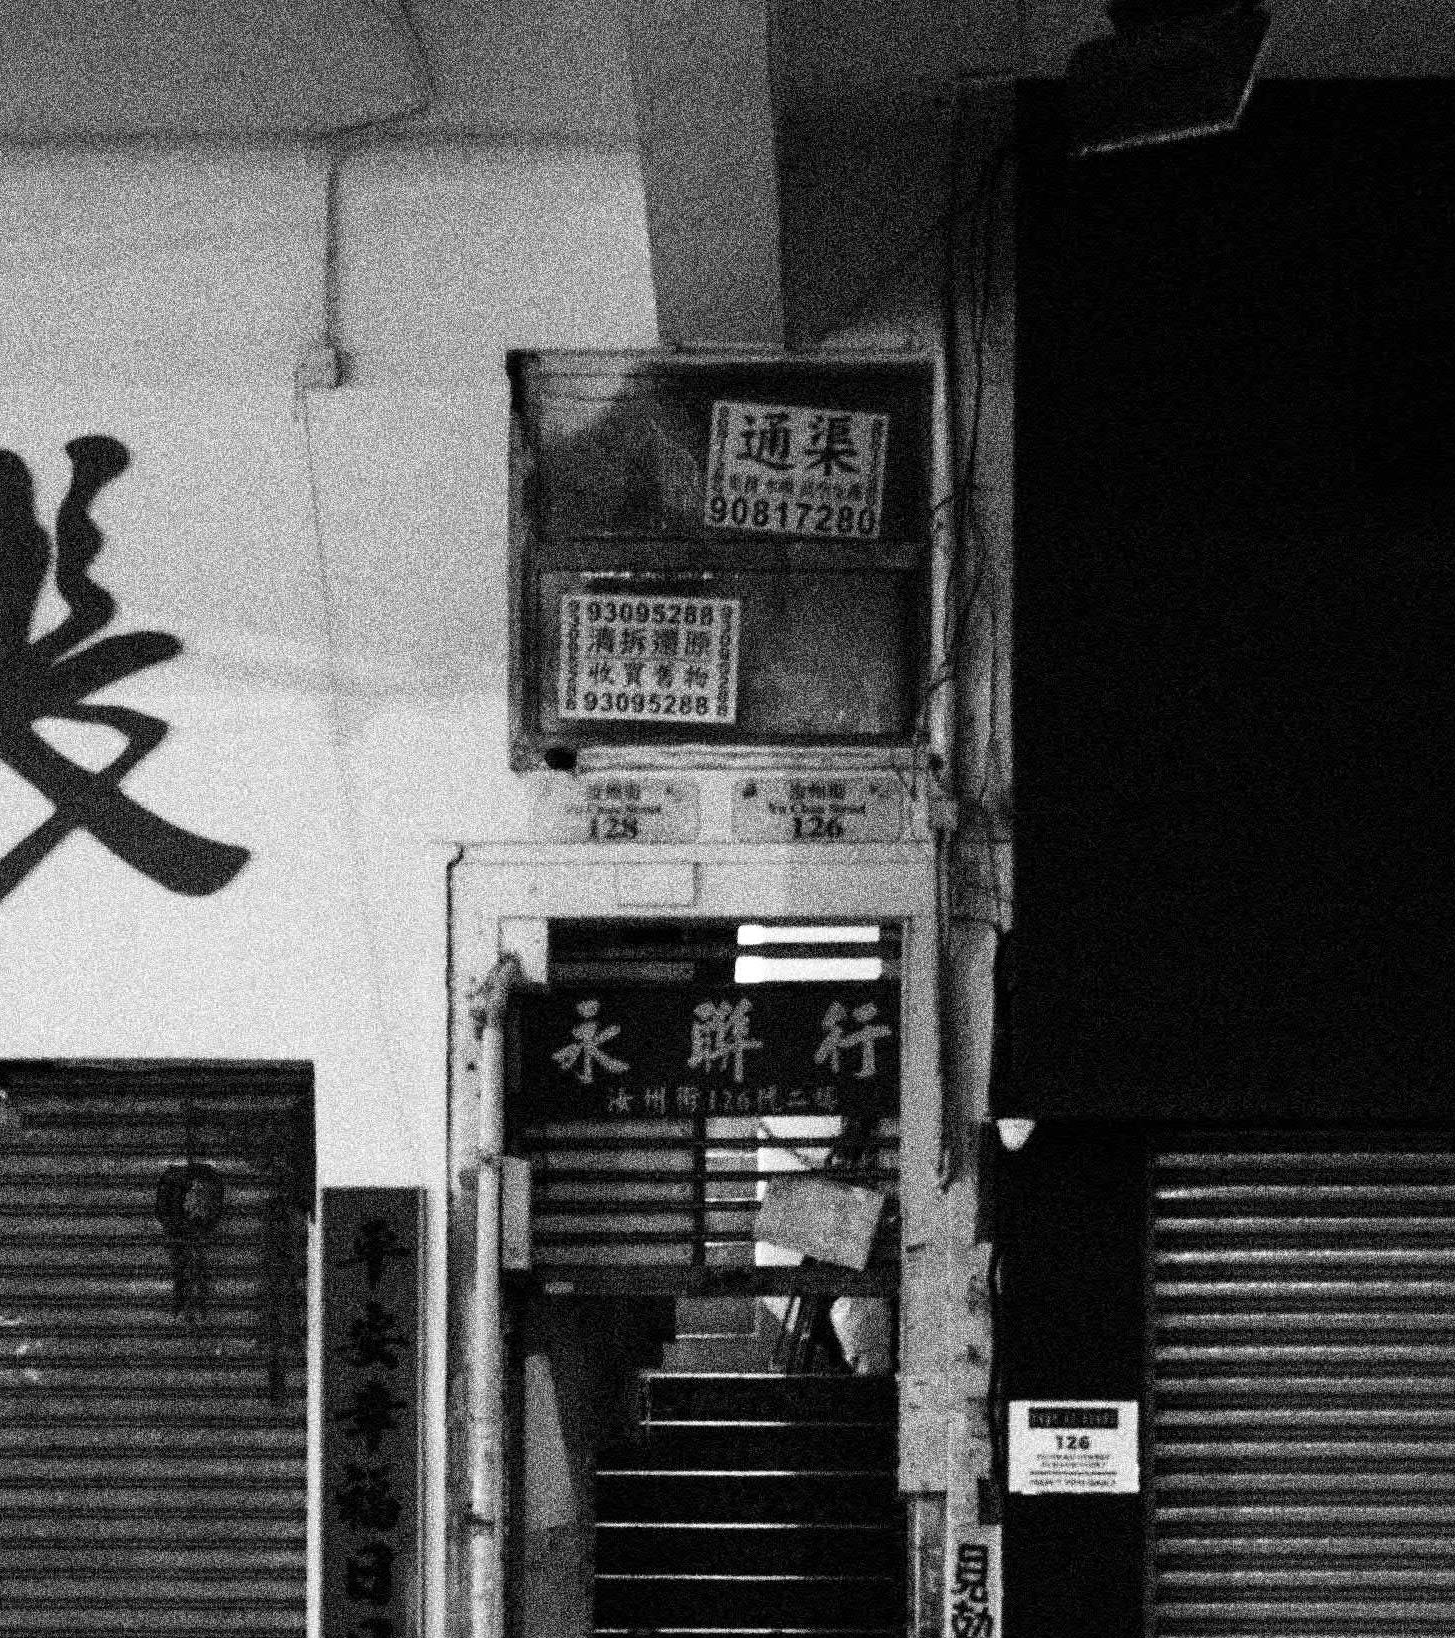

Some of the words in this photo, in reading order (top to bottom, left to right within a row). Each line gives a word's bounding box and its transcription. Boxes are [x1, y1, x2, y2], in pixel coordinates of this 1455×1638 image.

[736, 412, 860, 477] 通渠
[709, 495, 876, 536] 90817280
[587, 602, 714, 626] 93095288
[583, 692, 710, 716] 93095288
[587, 817, 639, 840] 128
[791, 816, 845, 840] 126
[1055, 1435, 1091, 1450] 126
